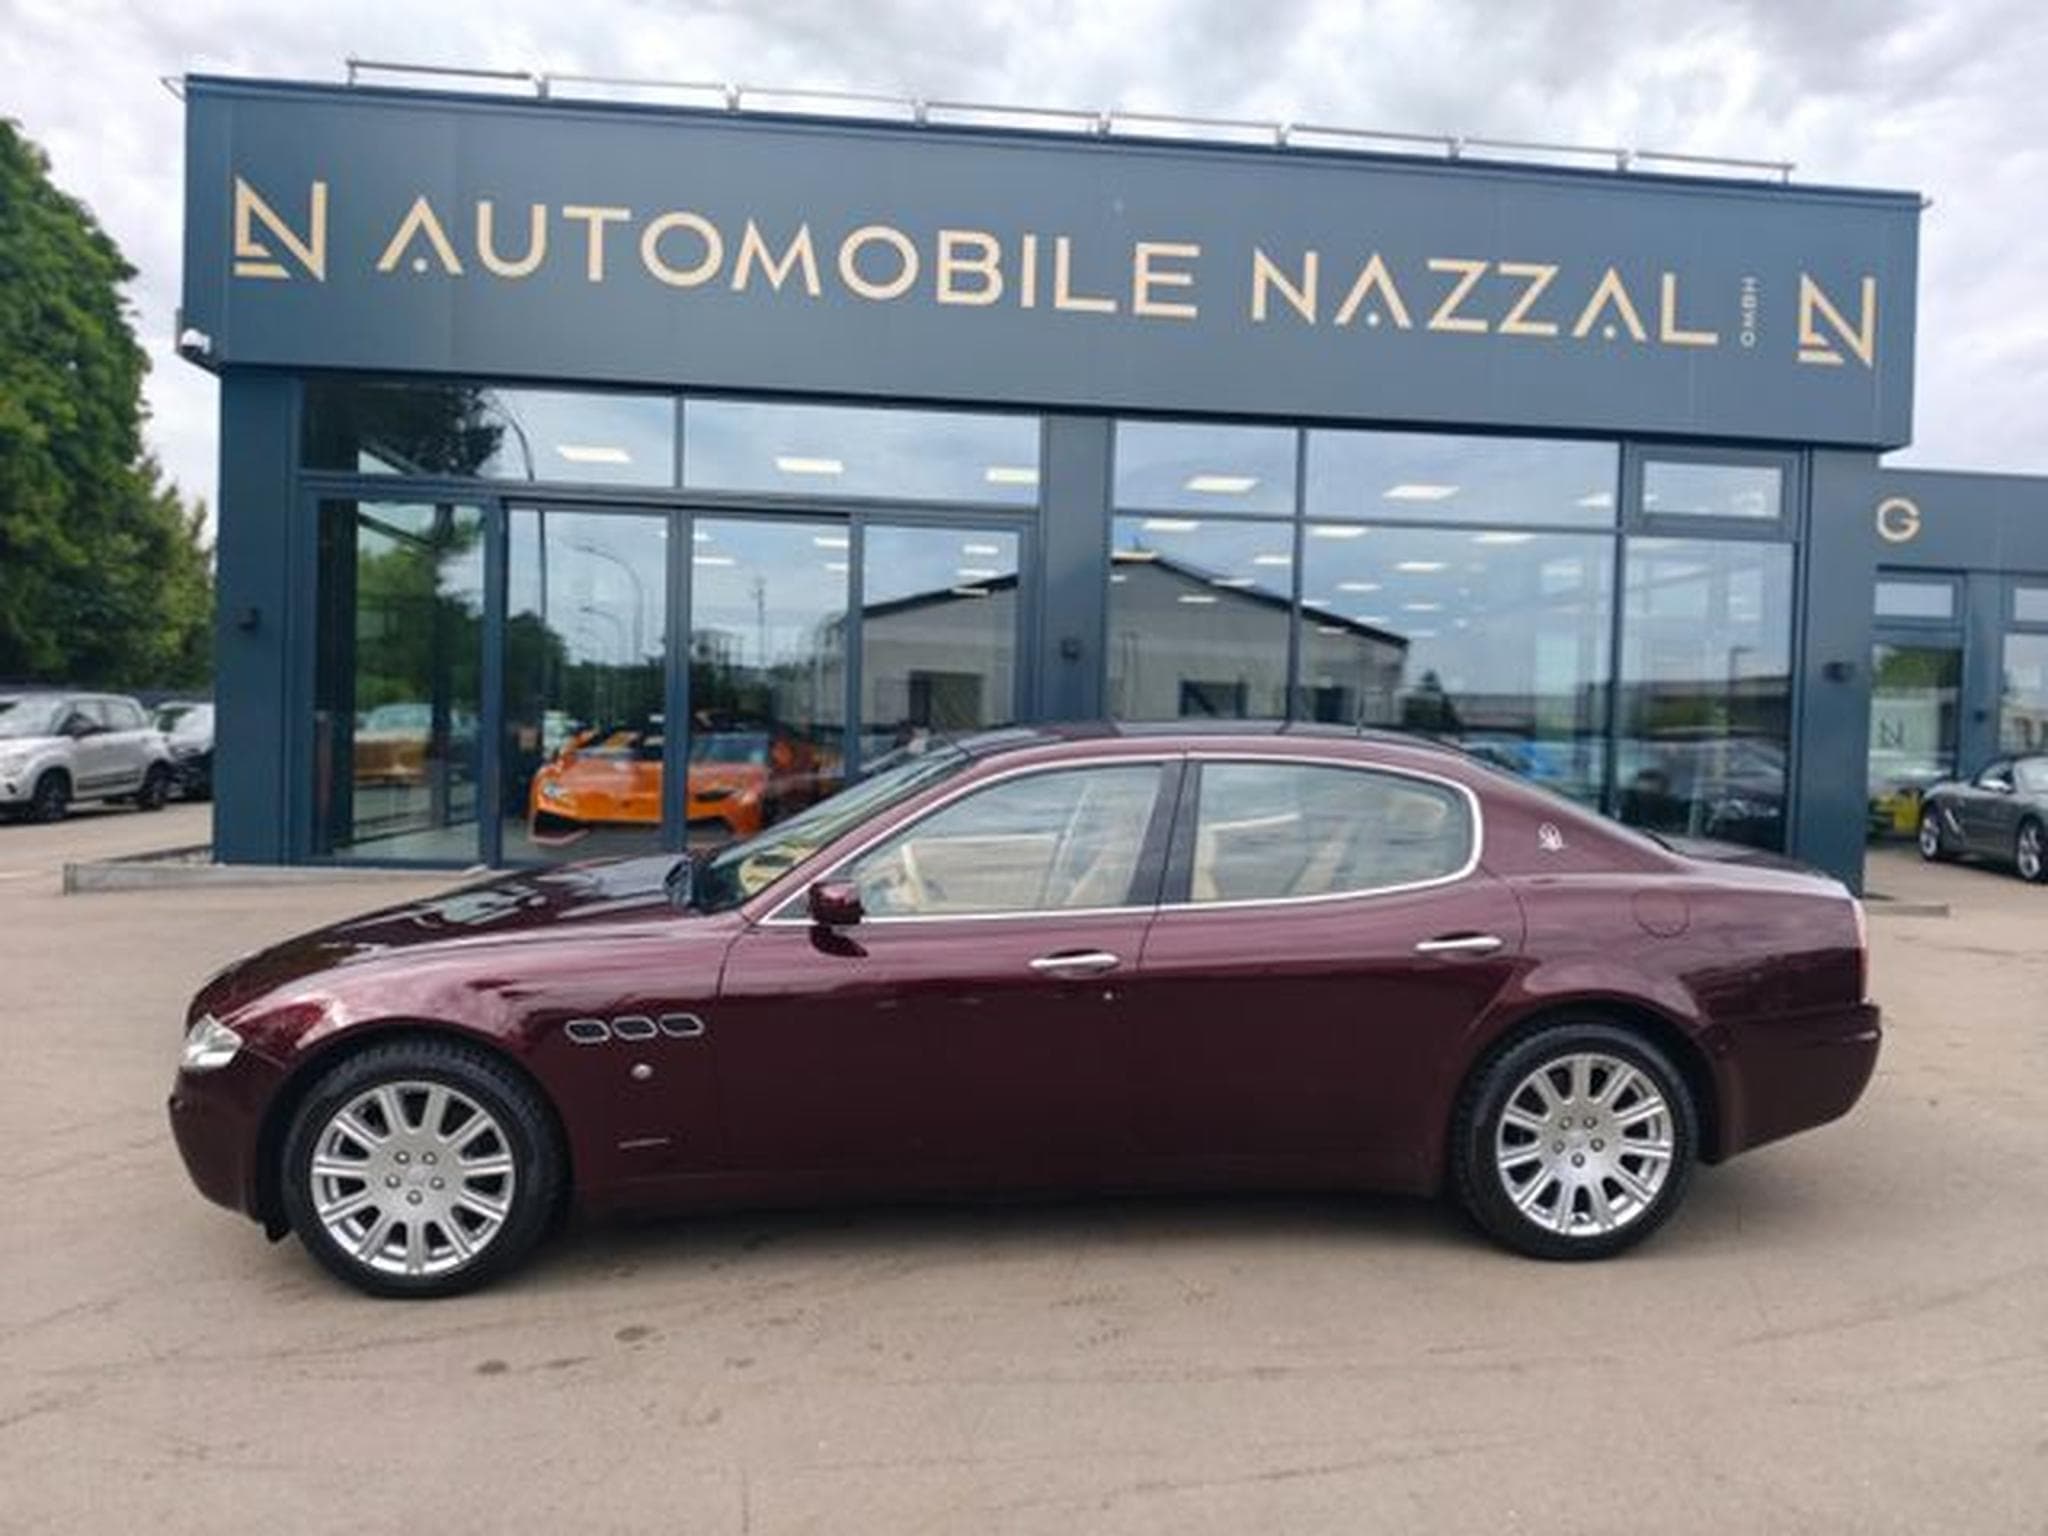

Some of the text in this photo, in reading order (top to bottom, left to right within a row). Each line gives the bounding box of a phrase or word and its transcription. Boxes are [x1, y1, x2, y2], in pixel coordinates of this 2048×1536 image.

[376, 196, 1202, 319] AUTOMOBILE
[1251, 248, 1721, 349] NAZZAL
[1876, 497, 1921, 542] G
